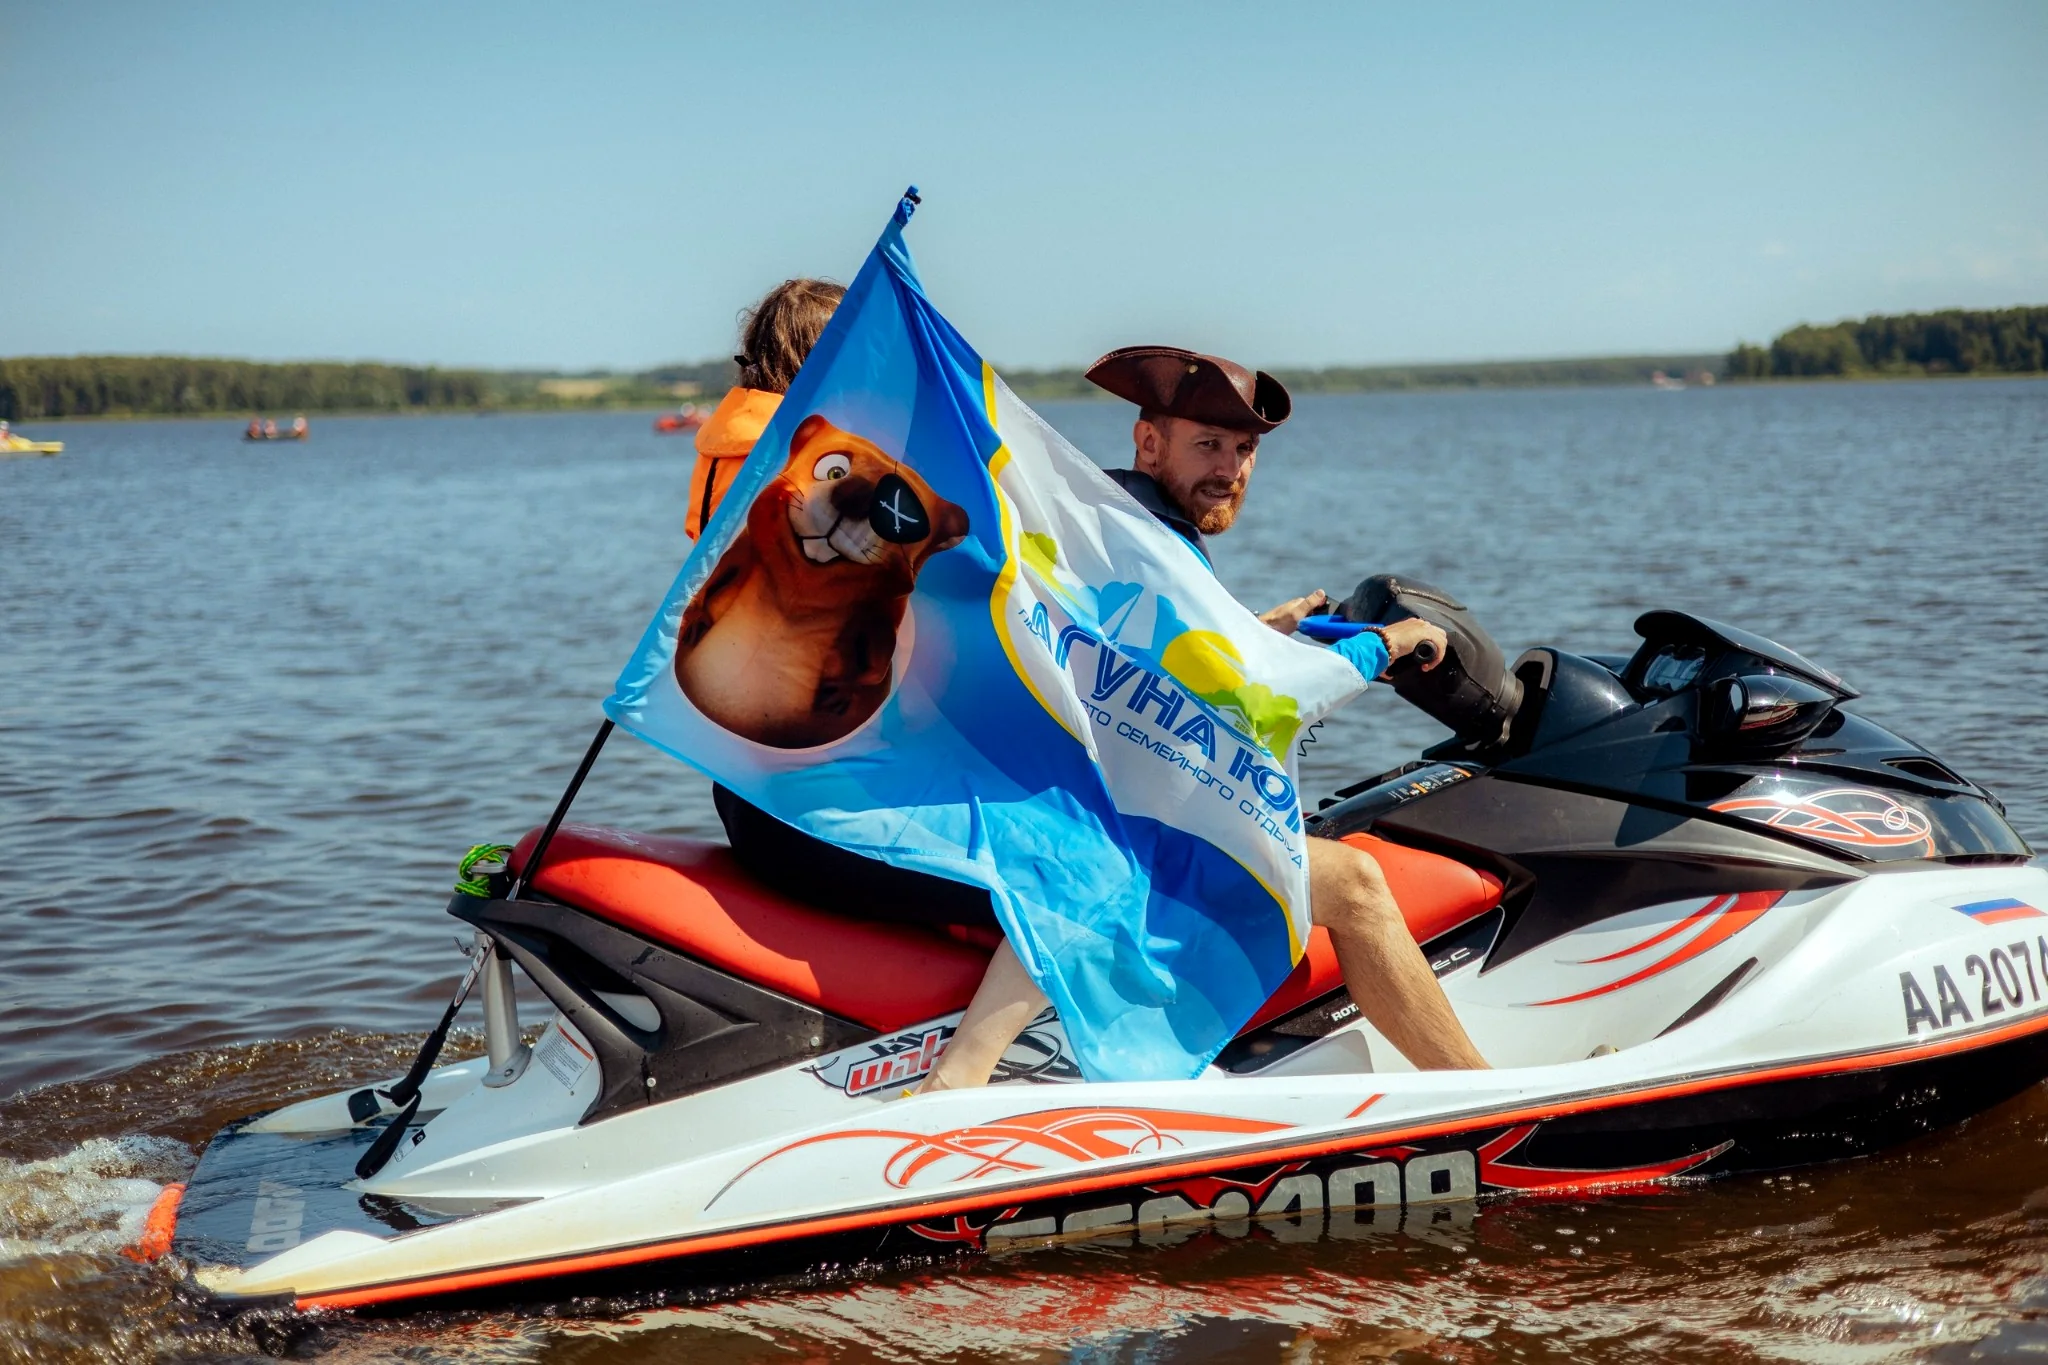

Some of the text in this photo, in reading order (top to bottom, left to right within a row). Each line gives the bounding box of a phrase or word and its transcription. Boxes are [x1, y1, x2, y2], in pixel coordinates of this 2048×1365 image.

[1032, 602, 1216, 763] АГУНА
[1116, 721, 1235, 801] СЕМЕЙНОГО
[1331, 1003, 1359, 1022] ROT
